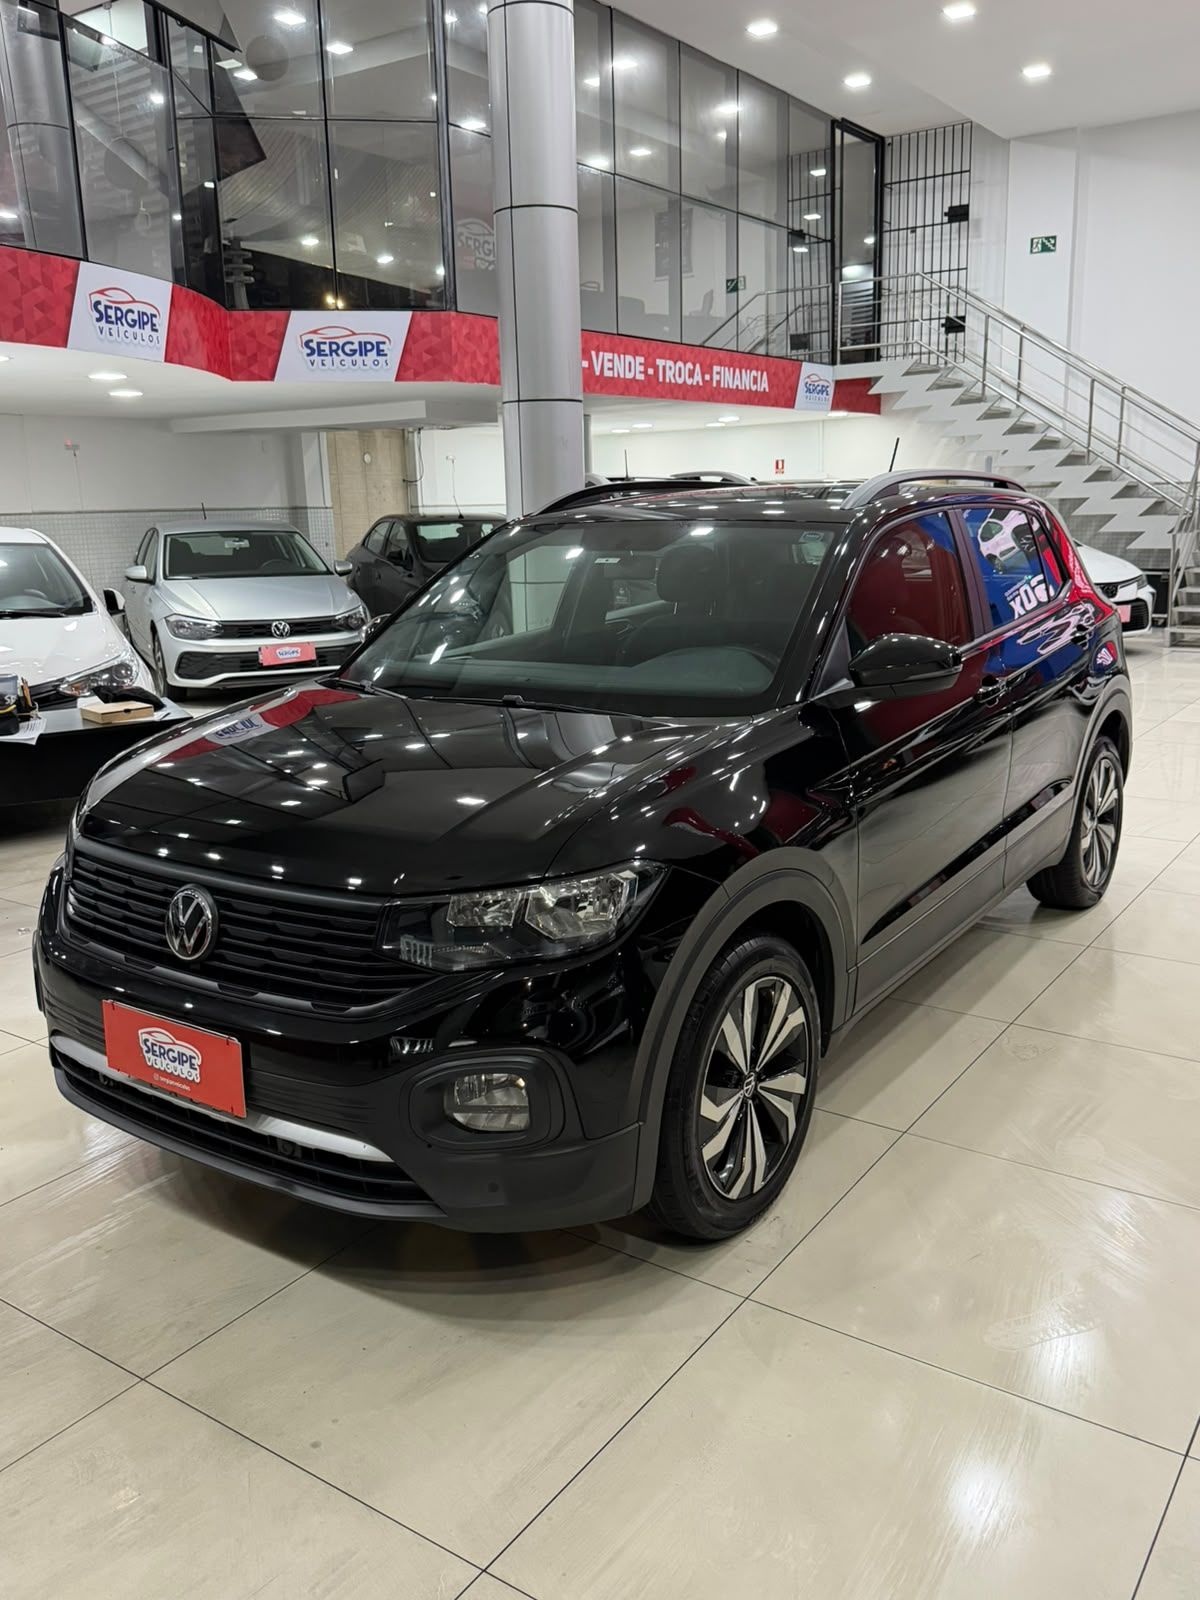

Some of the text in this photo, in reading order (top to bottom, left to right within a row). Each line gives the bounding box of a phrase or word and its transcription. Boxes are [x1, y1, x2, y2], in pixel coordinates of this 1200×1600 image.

[93, 299, 159, 333] SERGIPE
[98, 325, 160, 345] VEÍCULOS
[303, 338, 388, 358] SERGIPE
[309, 357, 389, 368] VEÍCULOS
[590, 350, 645, 381] VENDE
[655, 358, 703, 386] TROCA
[712, 365, 769, 393] FINANCIA
[804, 381, 830, 397] SERGIPE
[143, 1038, 198, 1071] SERGIPE
